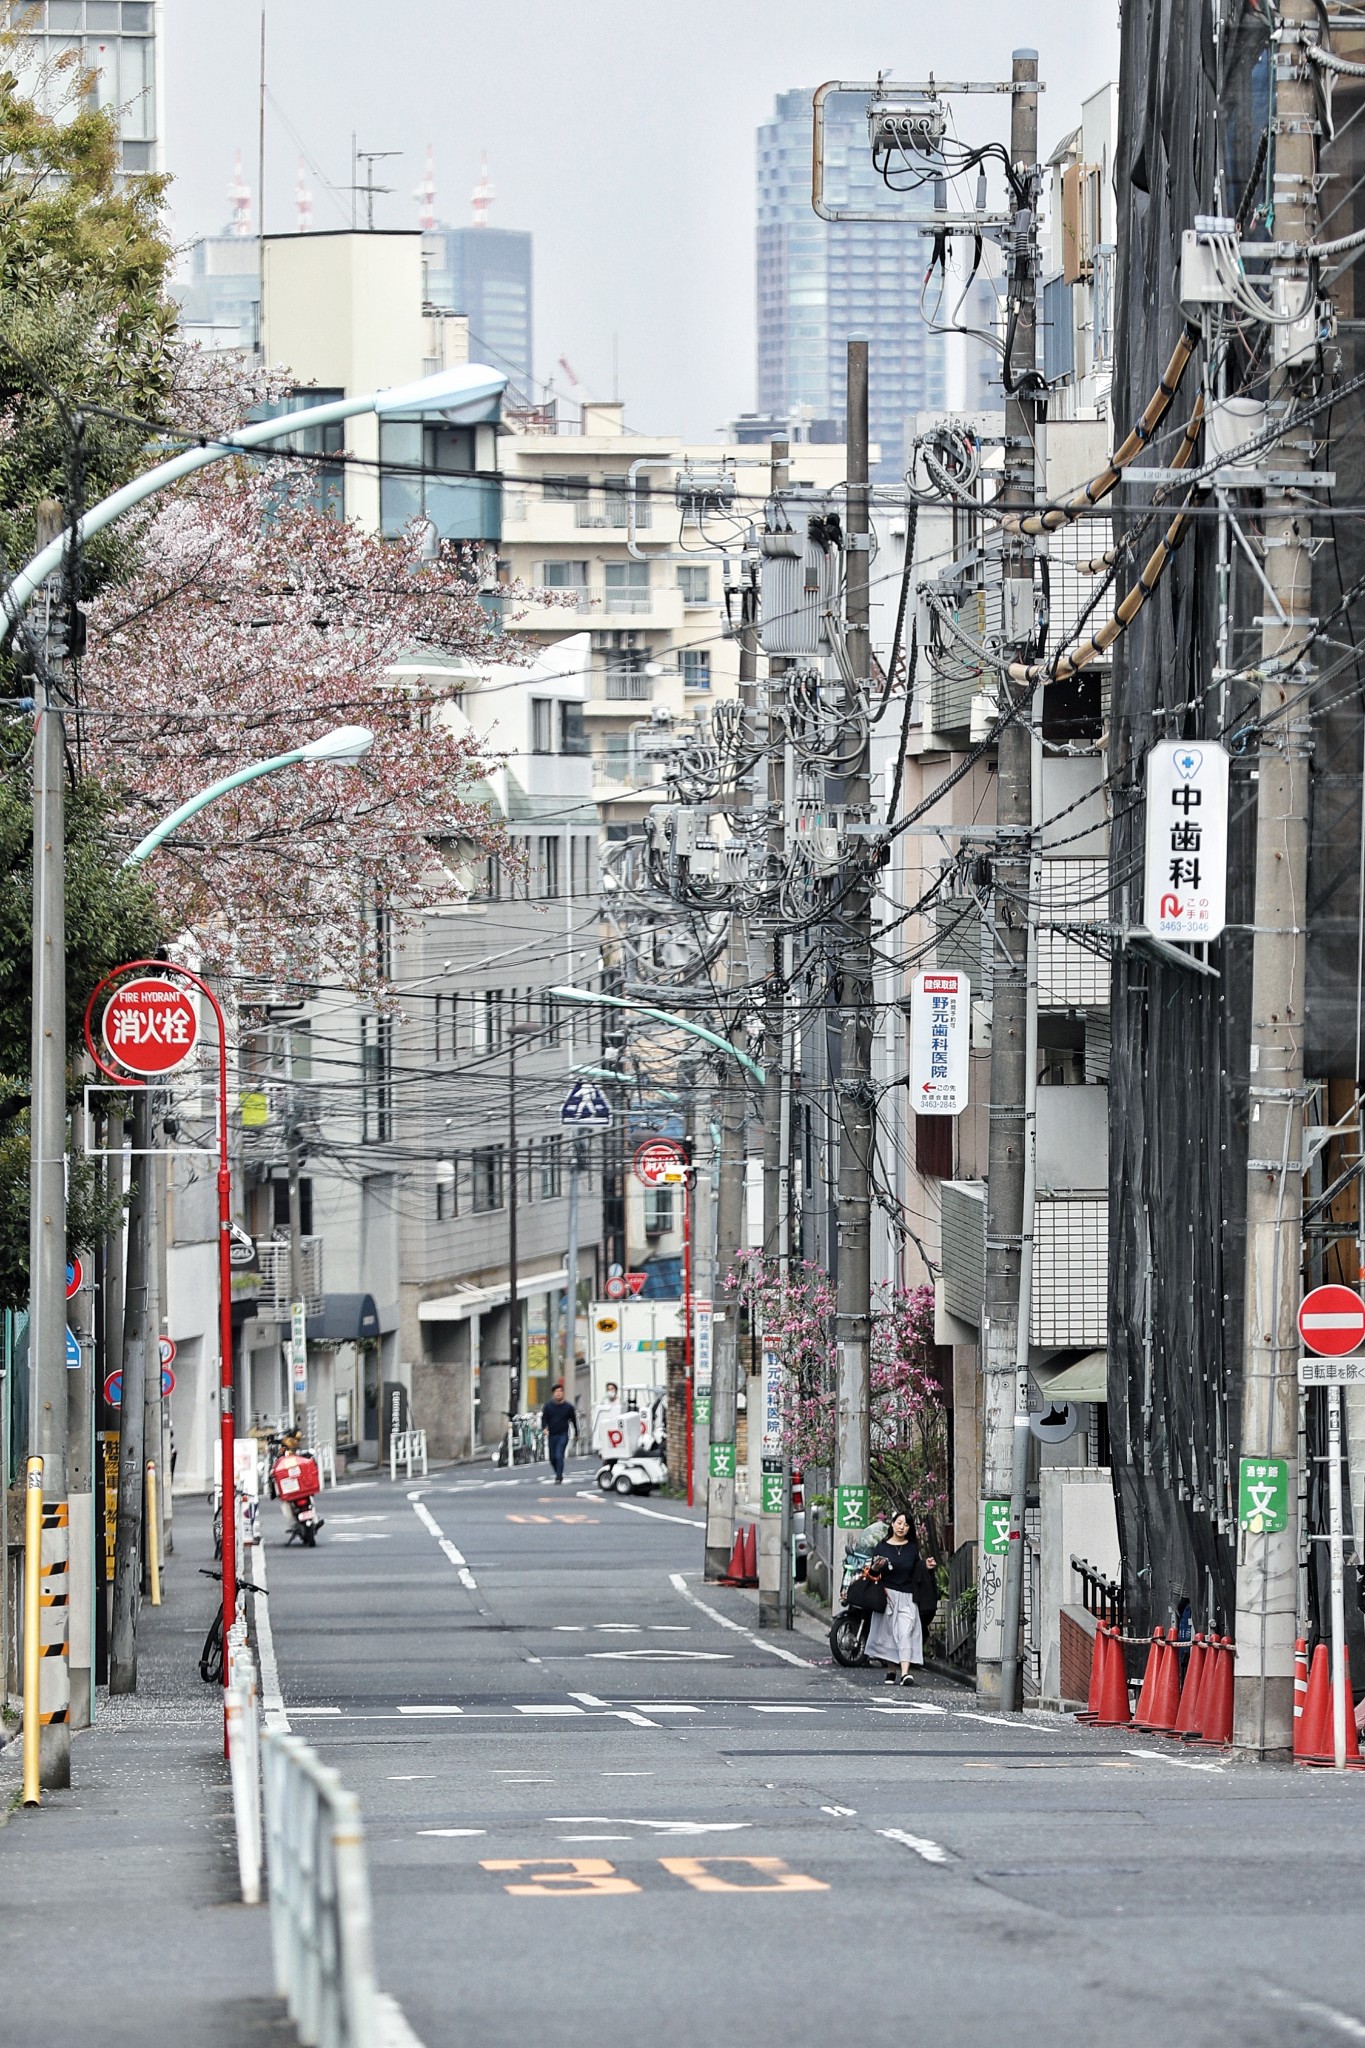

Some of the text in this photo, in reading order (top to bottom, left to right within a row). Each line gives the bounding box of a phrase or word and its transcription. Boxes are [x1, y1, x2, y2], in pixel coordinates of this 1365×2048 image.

[1169, 783, 1203, 890] 中歯科
[1186, 898, 1209, 908] この
[1186, 909, 1209, 920] 手前
[1160, 921, 1209, 932] 3463-3046
[120, 991, 181, 1003] FIRE HYDRANT
[112, 1007, 191, 1045] 消火栓
[932, 996, 949, 1079] 野元歯科医院
[1303, 1364, 1365, 1380] 自転車を除く
[1246, 1465, 1279, 1478] 通学路
[991, 1505, 1011, 1516] 通学
[478, 1856, 832, 1897] 30
